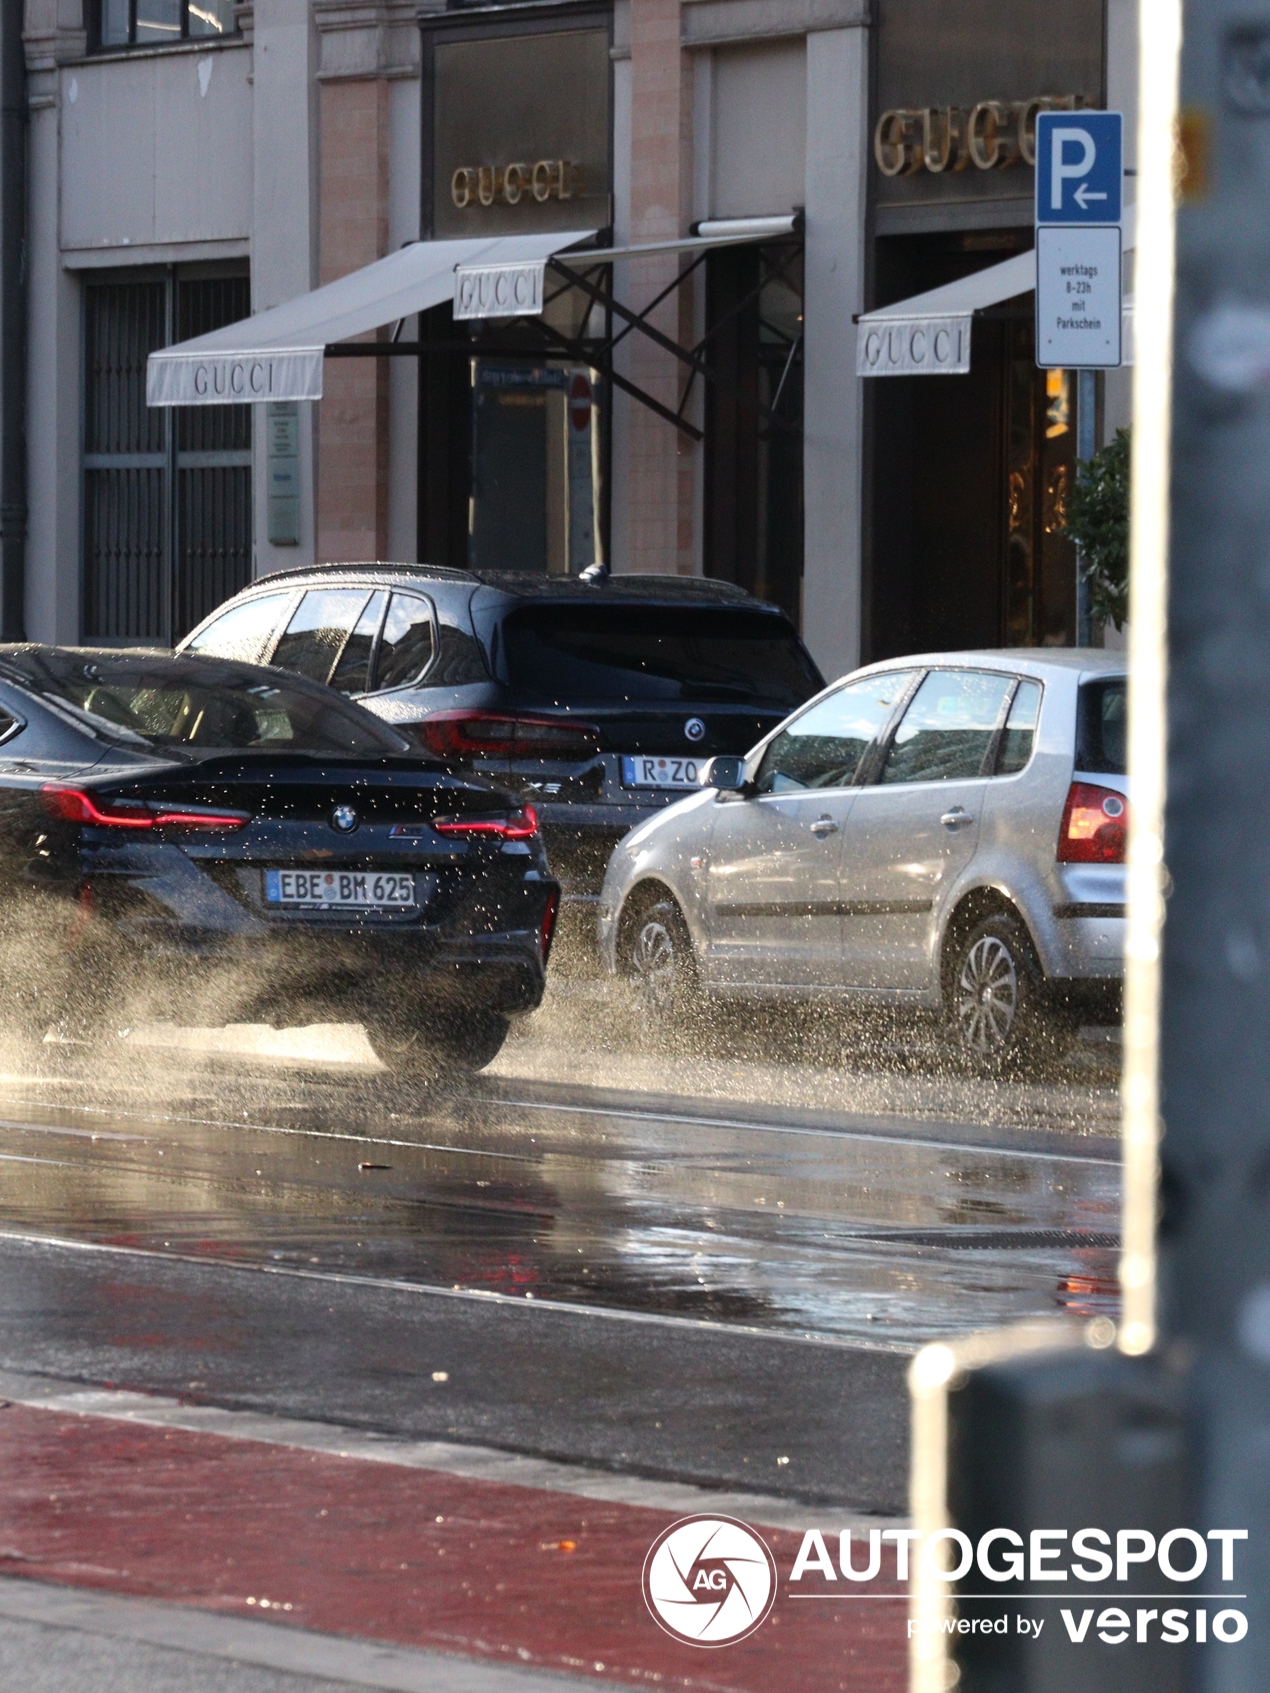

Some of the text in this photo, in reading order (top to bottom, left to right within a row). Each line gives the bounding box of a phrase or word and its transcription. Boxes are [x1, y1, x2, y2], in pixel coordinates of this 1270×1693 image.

[875, 96, 1070, 177] GUCC
[1051, 127, 1096, 210] P
[1059, 264, 1098, 279] werktags
[459, 269, 537, 309] GUCCI
[1066, 281, 1092, 294] 8-23h
[1071, 299, 1086, 312] mit
[1056, 316, 1101, 330] Parkschein
[864, 329, 963, 366] GUCCI
[193, 362, 274, 396] GUCCI
[643, 760, 657, 782] R
[281, 874, 411, 902] EBE BM 625
